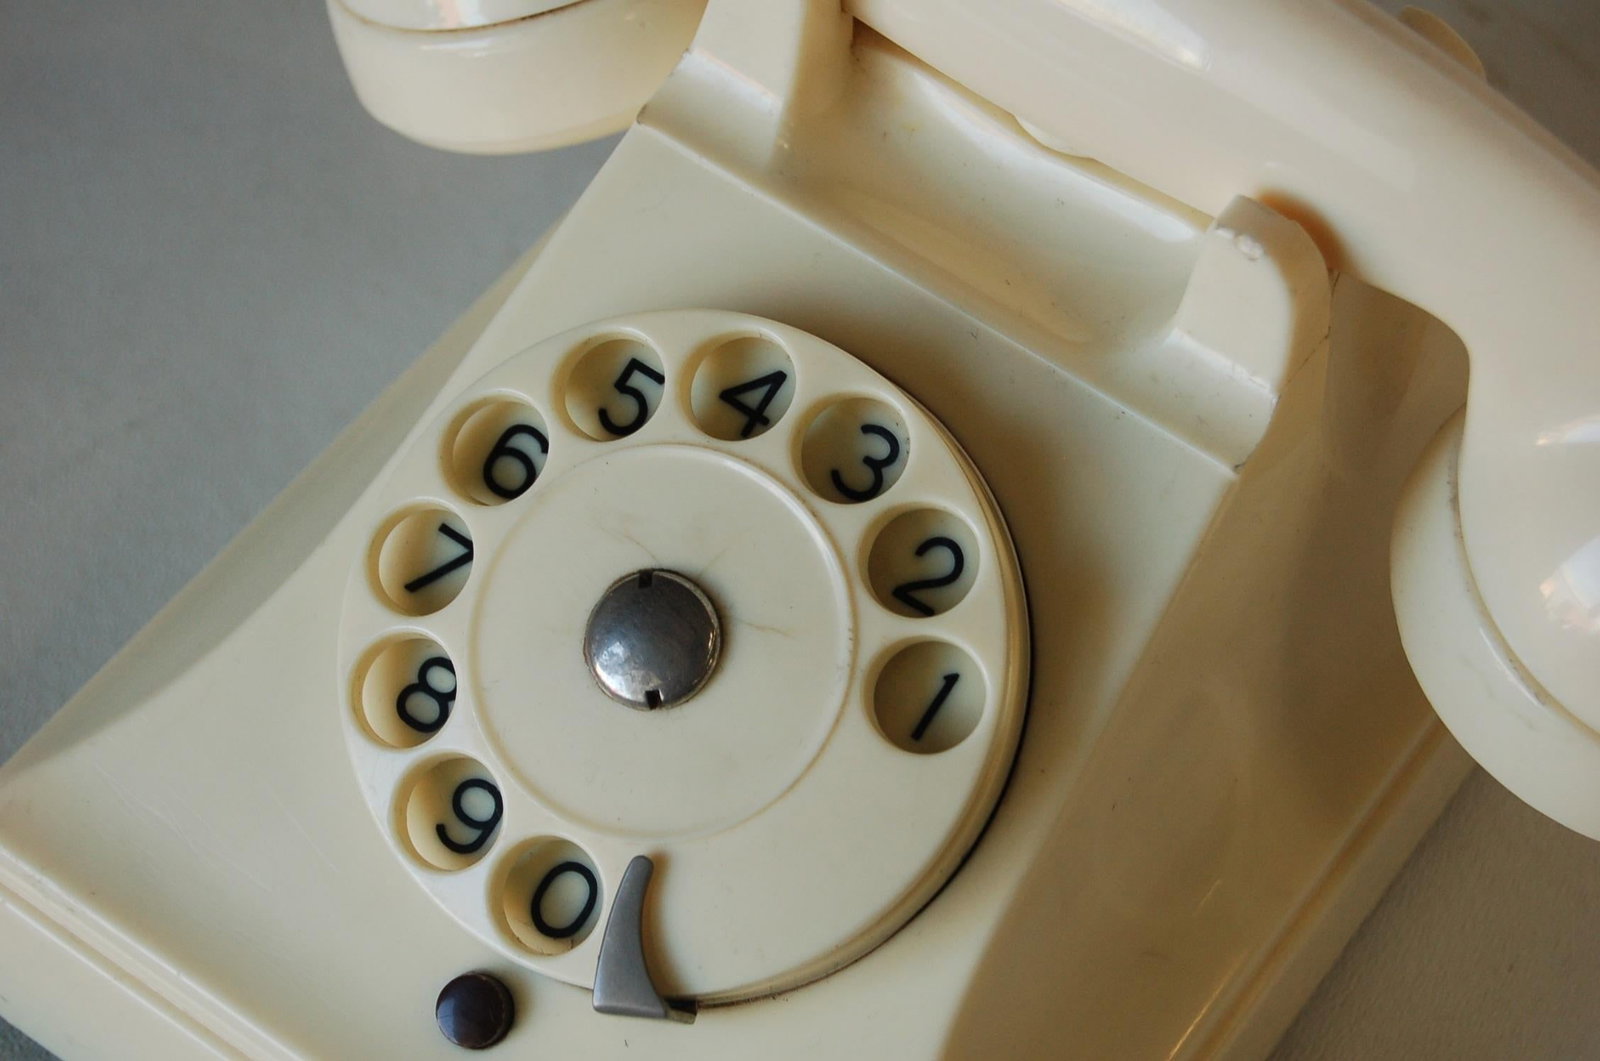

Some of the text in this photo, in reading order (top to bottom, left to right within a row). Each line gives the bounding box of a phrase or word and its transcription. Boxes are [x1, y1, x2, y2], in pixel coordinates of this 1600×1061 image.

[598, 358, 665, 436] 5
[720, 370, 787, 438] 4
[483, 425, 549, 500] 6
[830, 424, 900, 503] 3
[404, 523, 473, 593] 7
[893, 537, 965, 617] 2
[397, 657, 457, 733] 8
[911, 672, 960, 741] 1
[436, 778, 503, 854] 9
[531, 861, 598, 938] 0
